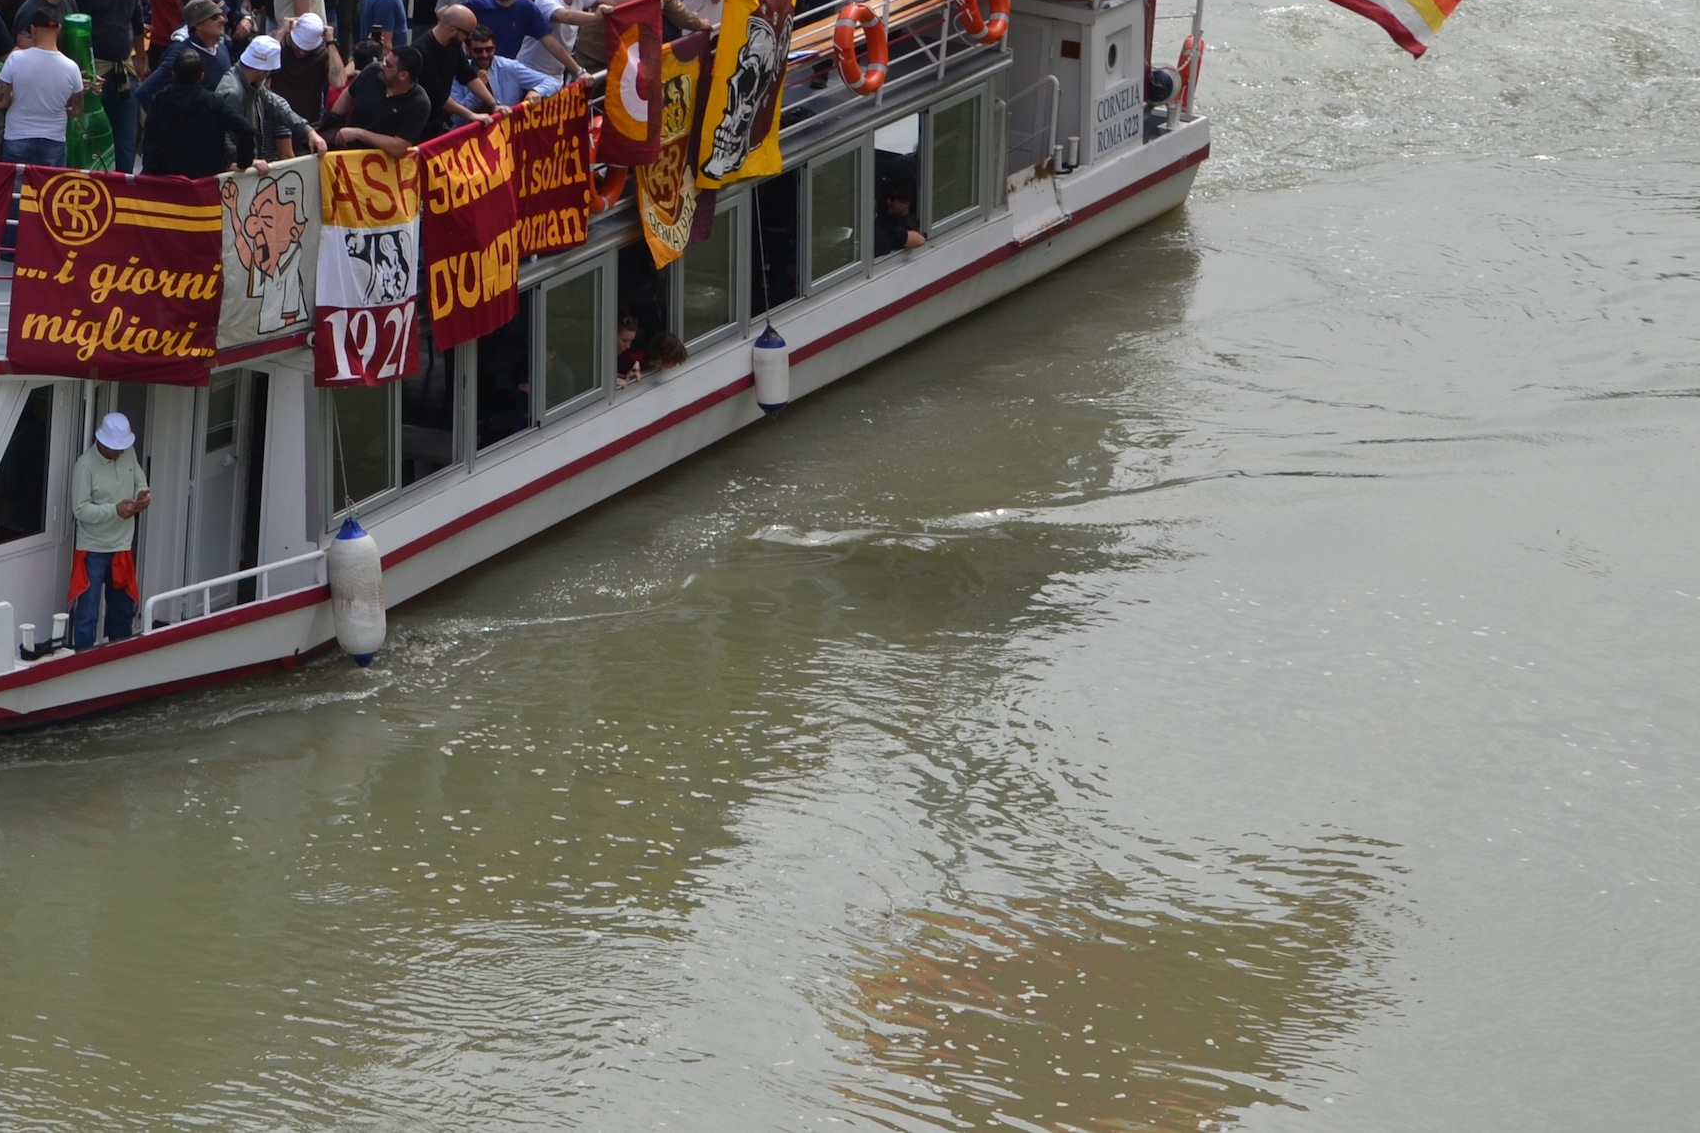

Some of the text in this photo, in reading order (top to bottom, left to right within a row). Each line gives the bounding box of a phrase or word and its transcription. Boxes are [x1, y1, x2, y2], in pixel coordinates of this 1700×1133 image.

[1096, 83, 1140, 123] CORNELIA
[1097, 114, 1139, 153] ROMA 8223
[329, 150, 420, 222] ASR
[518, 135, 588, 198] i soliti
[89, 256, 222, 304] giorni
